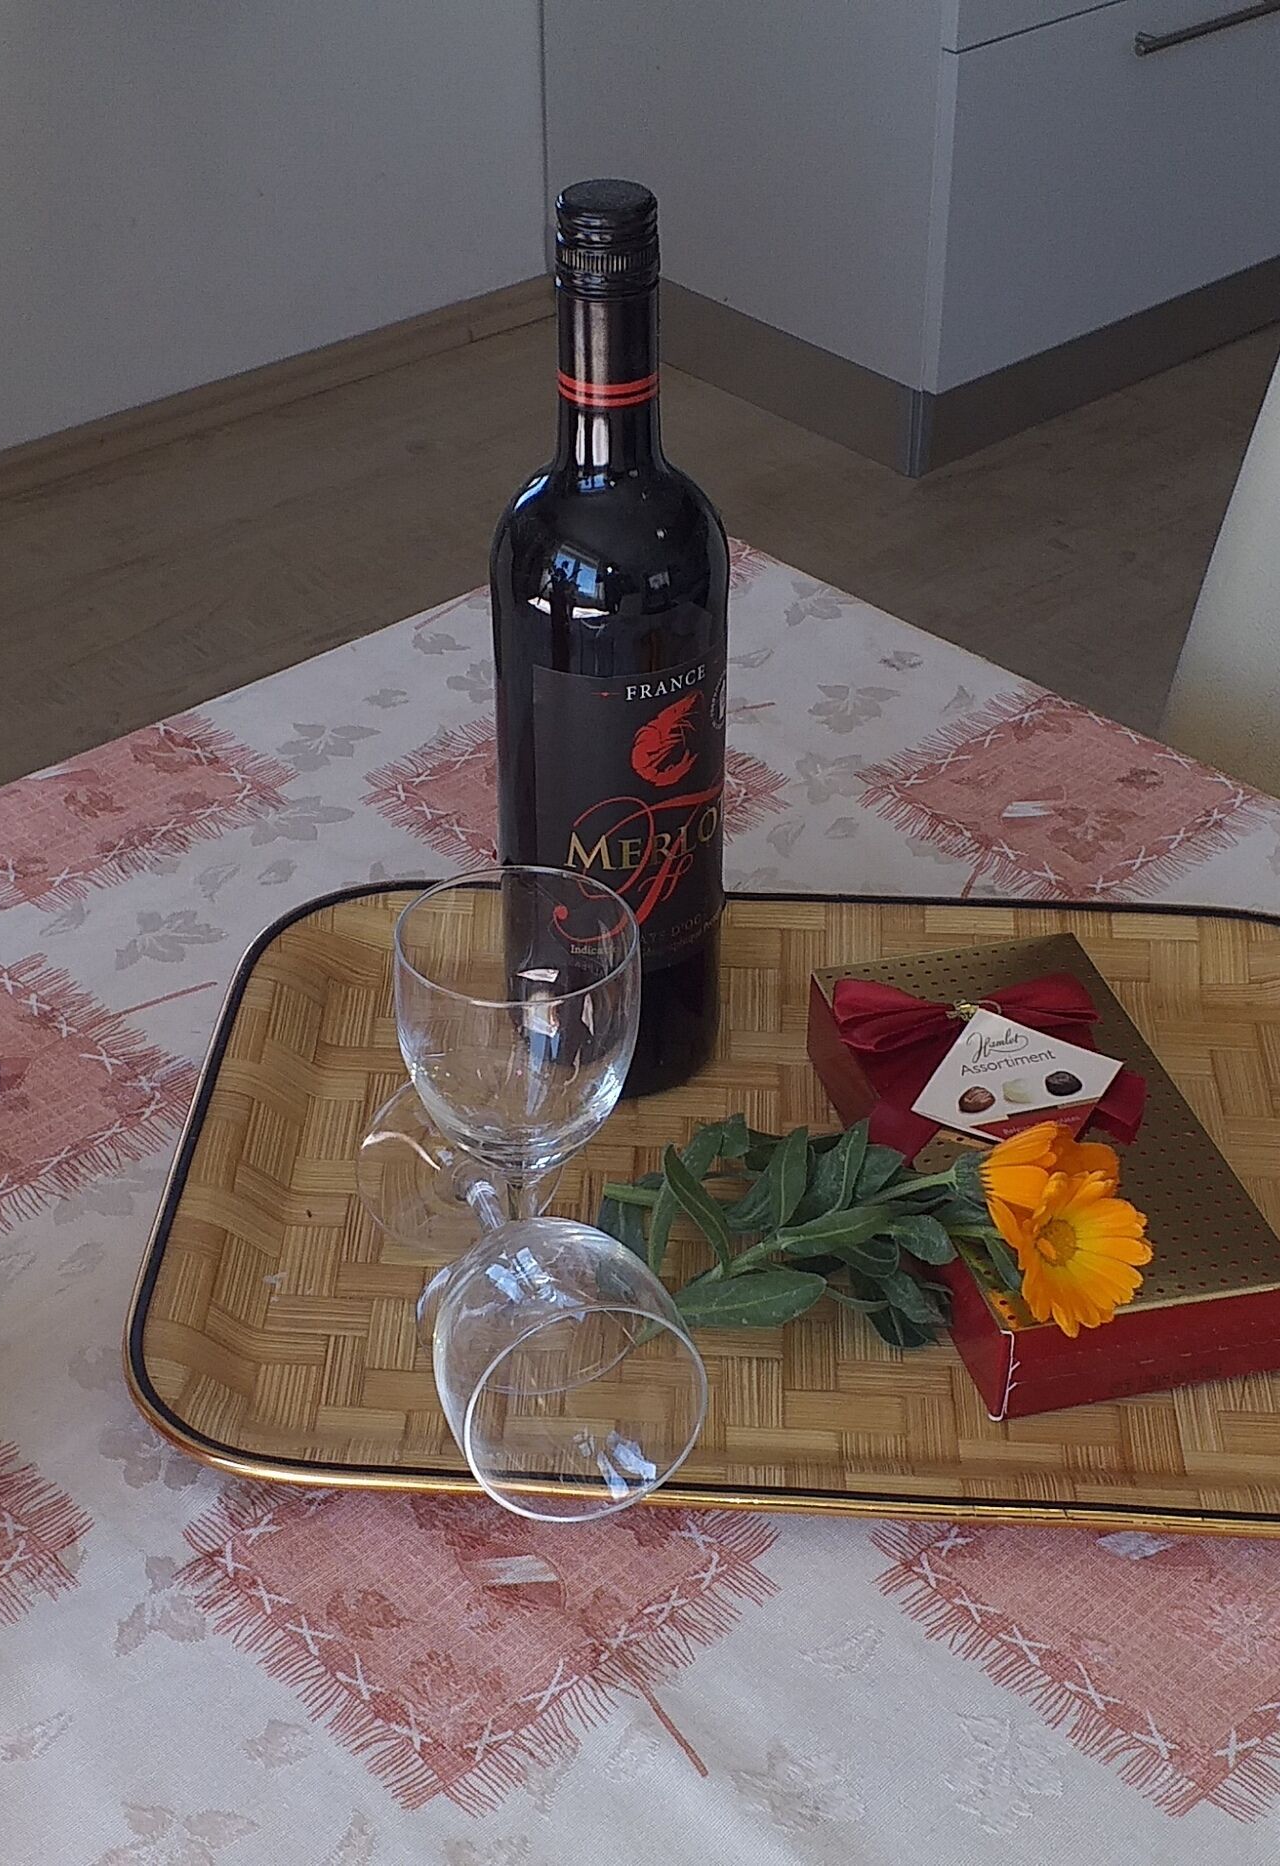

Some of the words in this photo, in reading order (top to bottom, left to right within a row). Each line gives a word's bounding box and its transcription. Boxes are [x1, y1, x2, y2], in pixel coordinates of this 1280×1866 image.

[625, 663, 706, 701] FRANCE
[961, 1049, 1057, 1076] Assortiment
[966, 1027, 1029, 1064] Hamlet
